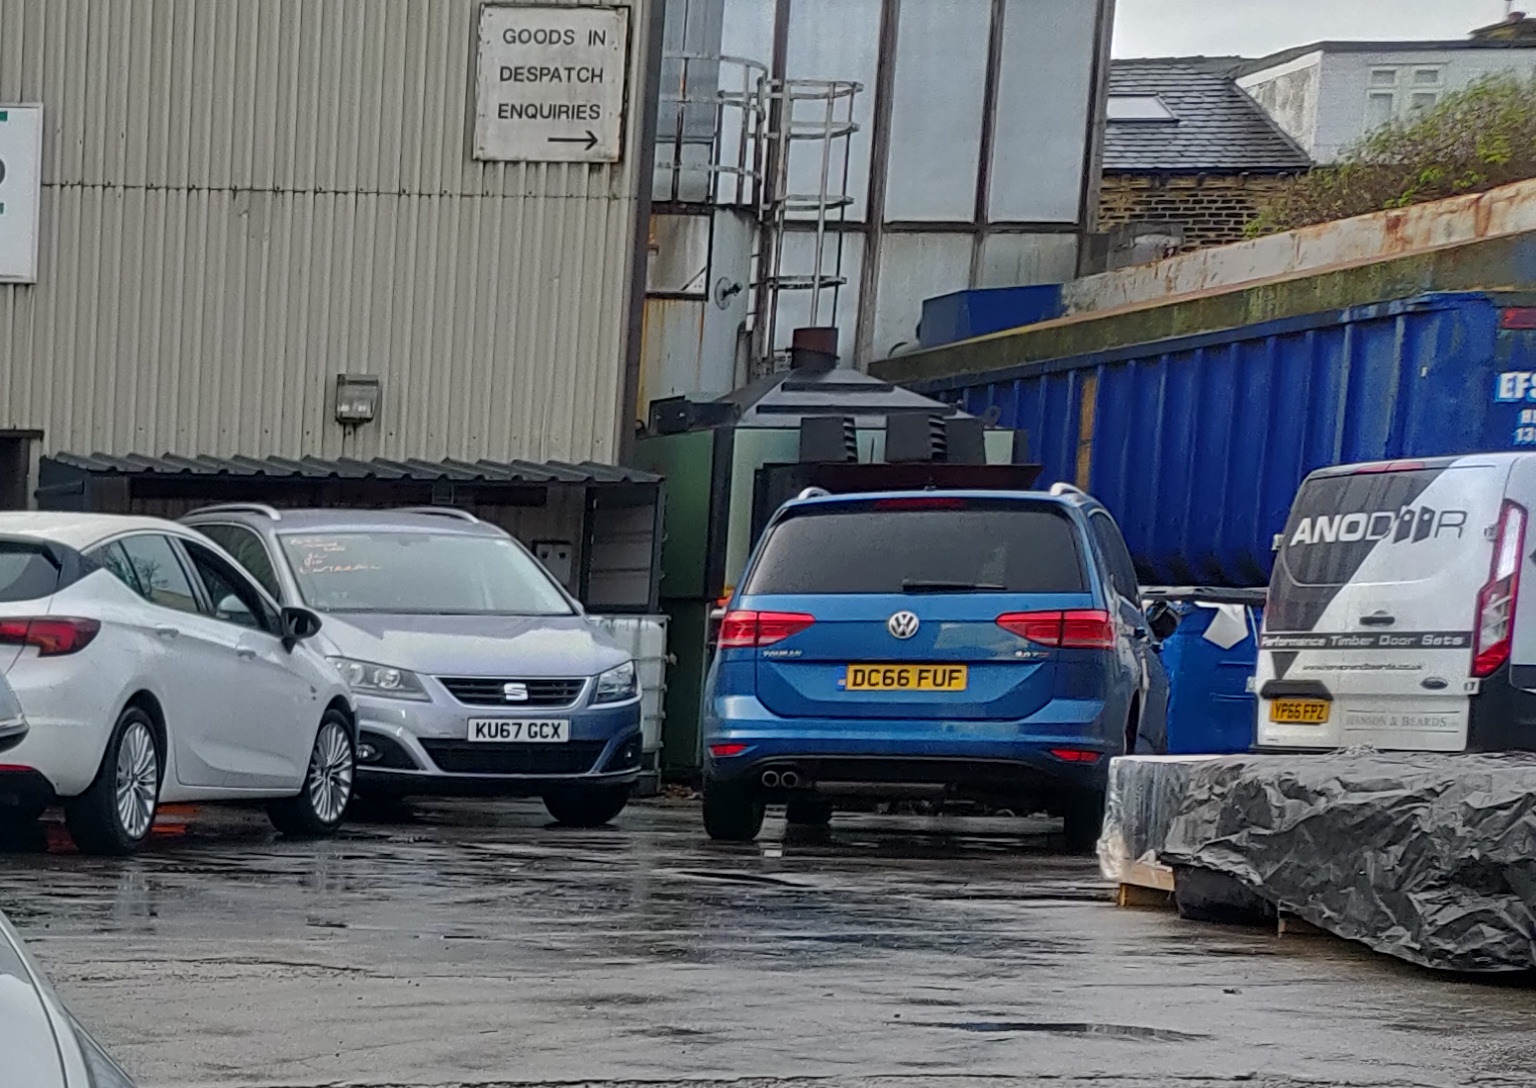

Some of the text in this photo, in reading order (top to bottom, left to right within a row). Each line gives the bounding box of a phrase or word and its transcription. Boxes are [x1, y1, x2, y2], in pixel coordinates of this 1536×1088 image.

[503, 28, 606, 46] GOODS IN
[499, 66, 603, 83] DESPATCH
[497, 103, 601, 120] ENQUIRIES
[1378, 635, 1416, 646] Door
[852, 668, 963, 687] DC66 FUF
[475, 722, 561, 739] KU67 GCX
